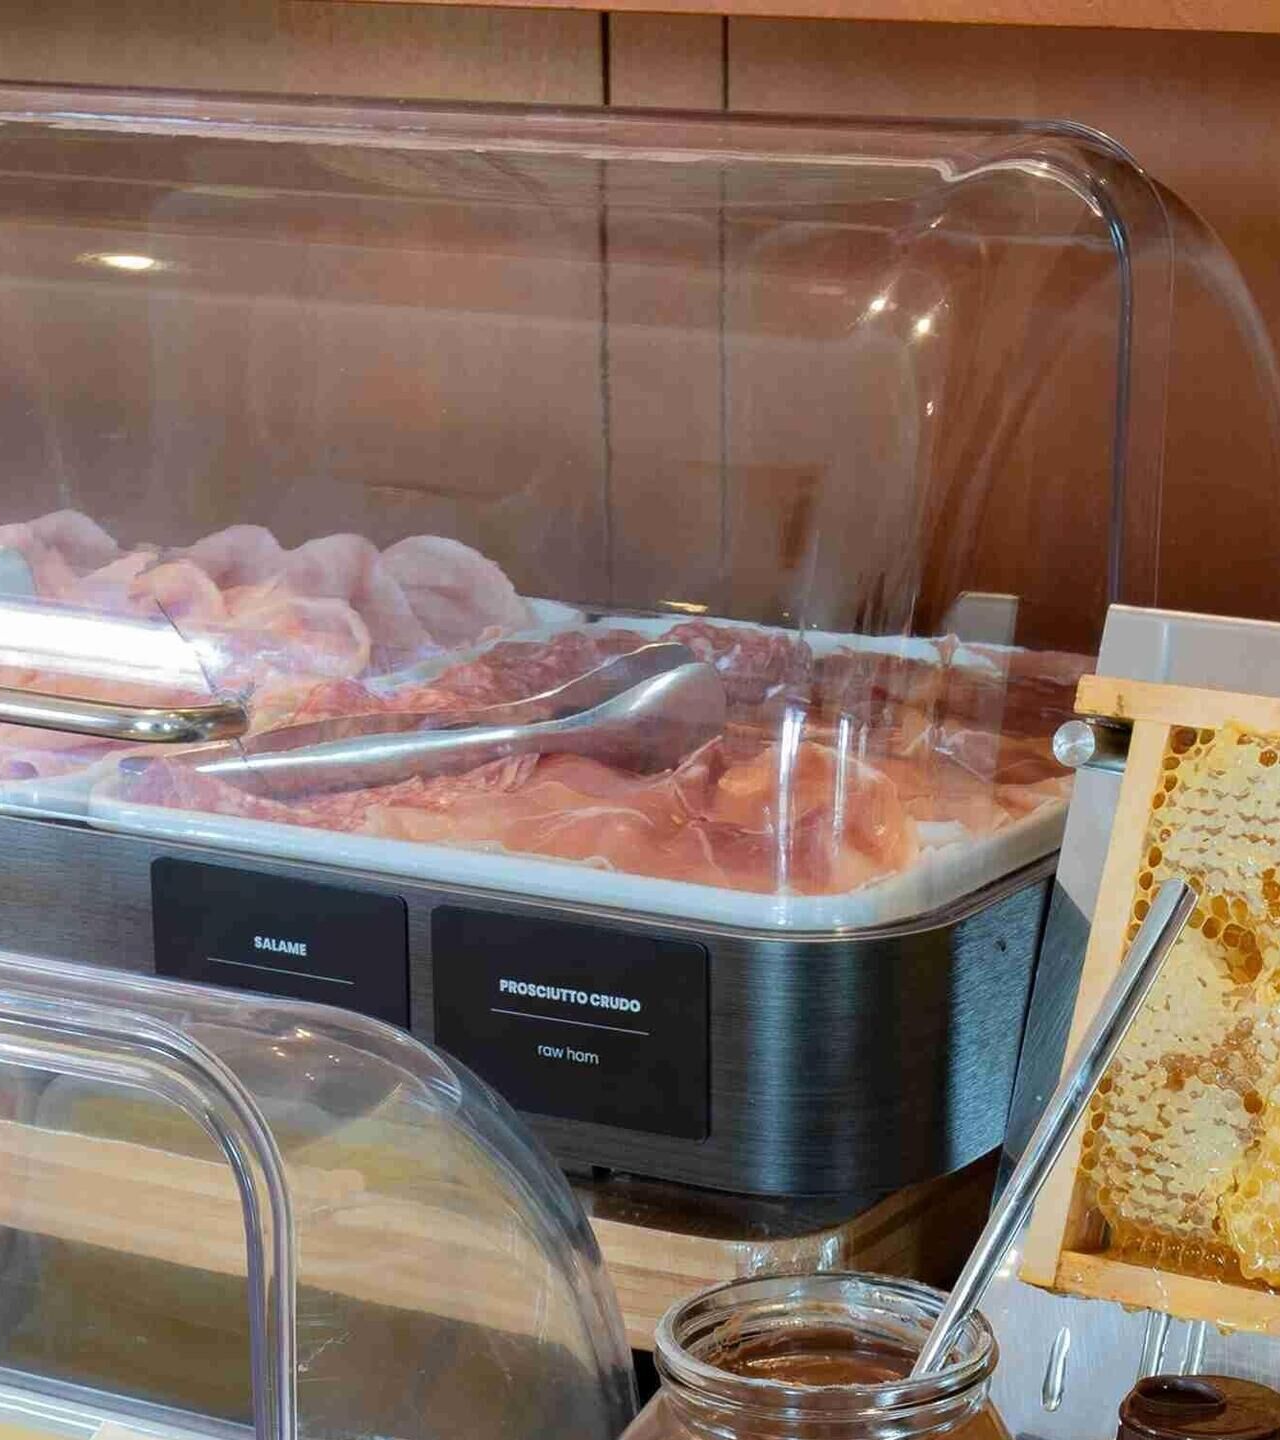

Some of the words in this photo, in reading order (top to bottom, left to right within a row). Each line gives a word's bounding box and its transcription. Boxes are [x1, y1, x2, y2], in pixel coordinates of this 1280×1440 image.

[254, 936, 307, 957] SALAME
[499, 979, 588, 1005] PROSCIUTTO
[590, 994, 641, 1013] CRUDO
[537, 1042, 564, 1060] raw
[566, 1046, 599, 1065] ham
